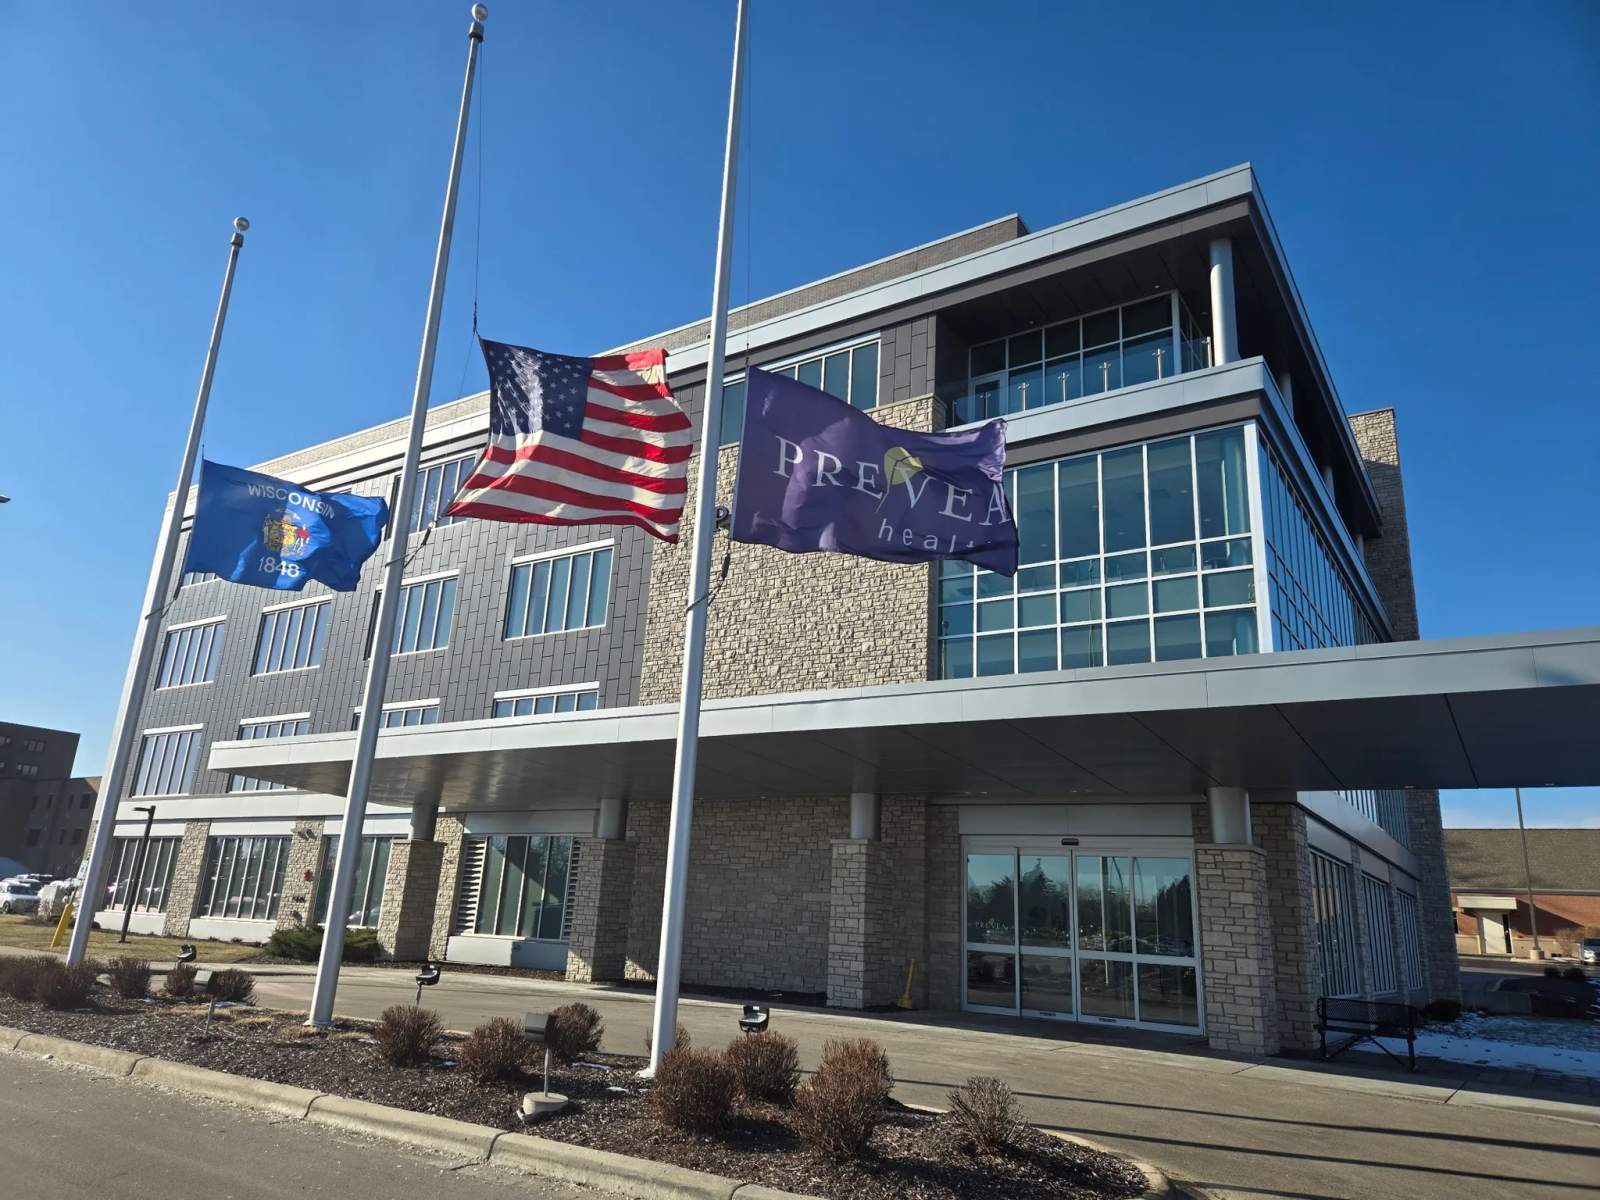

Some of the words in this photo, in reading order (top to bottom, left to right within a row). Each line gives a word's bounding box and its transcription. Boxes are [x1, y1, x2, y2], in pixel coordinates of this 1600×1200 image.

[774, 435, 1011, 526] PREVEA
[248, 484, 334, 519] WISCONSIN
[878, 518, 992, 553] heal
[259, 556, 300, 577] 1848
